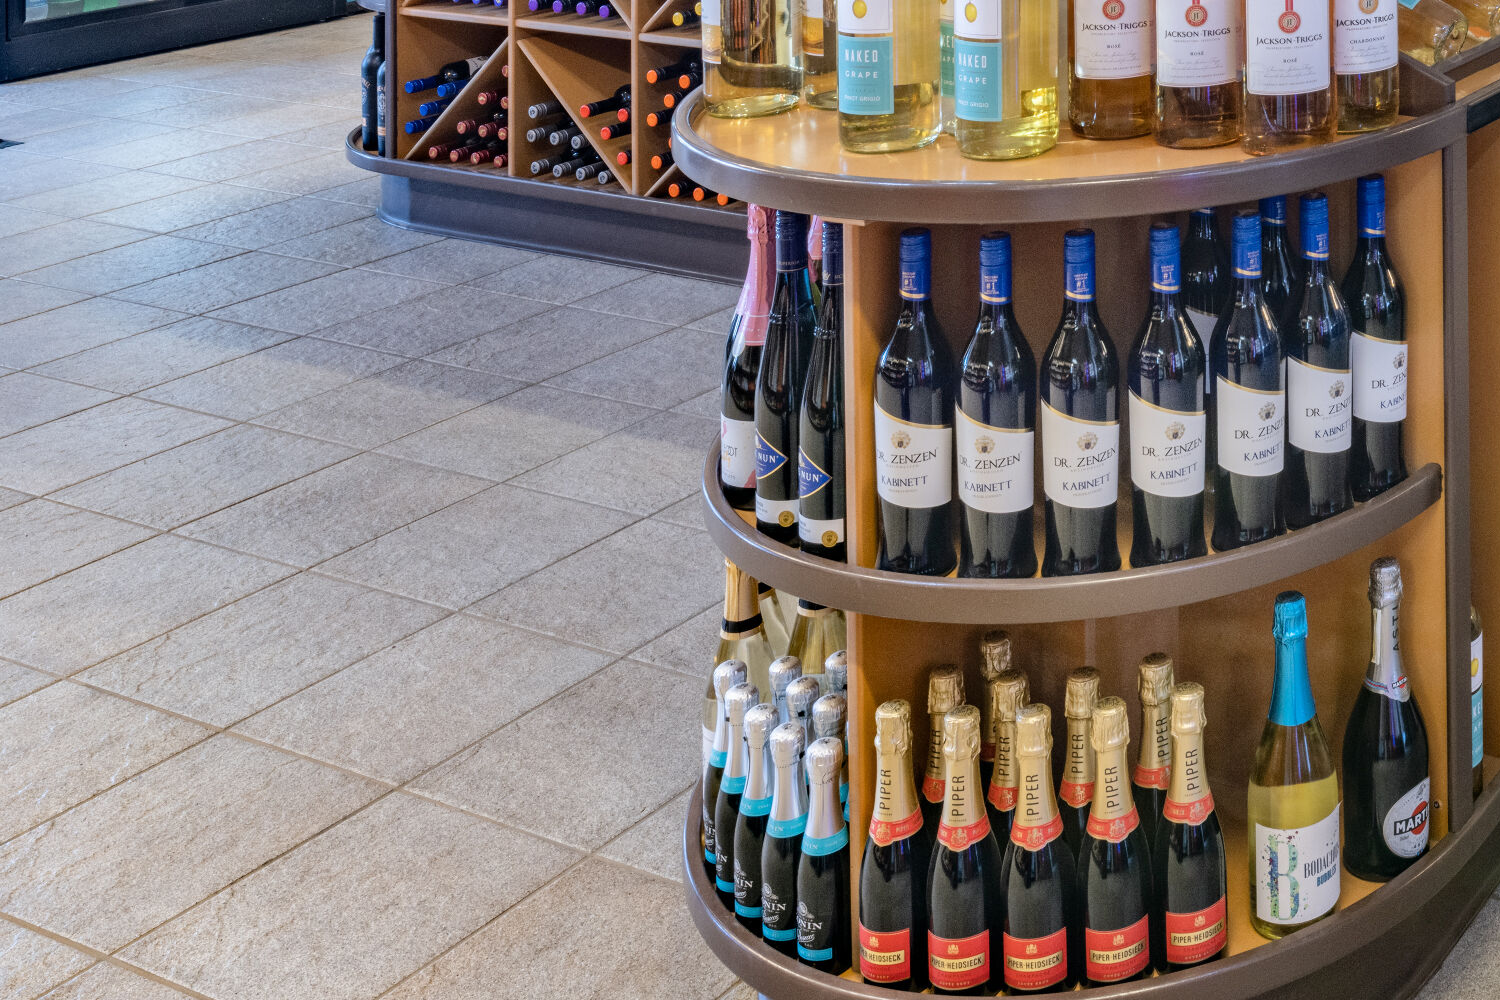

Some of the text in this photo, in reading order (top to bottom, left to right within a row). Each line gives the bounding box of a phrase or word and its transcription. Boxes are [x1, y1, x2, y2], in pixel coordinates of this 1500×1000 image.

[844, 49, 879, 63] NAKED
[958, 52, 987, 69] NAKED
[844, 70, 879, 79] GRAPE
[958, 74, 987, 85] GRAPE
[1371, 378, 1388, 390] DR.
[1305, 407, 1322, 418] DR.
[1234, 428, 1252, 440] DR.
[890, 449, 937, 464] ZENZEN
[1142, 437, 1202, 458] DR. ZENZEN
[757, 453, 778, 464] NUN
[959, 452, 1021, 470] DR. ZENZEN
[1054, 446, 1117, 468] DR. ZENZEN
[800, 472, 821, 483] NUN
[1150, 461, 1199, 480] KABINETT
[881, 475, 929, 487] KABINETT
[964, 480, 1013, 493] KABINETT
[1062, 475, 1110, 493] KABINETT
[1156, 715, 1169, 758] PIPER
[931, 728, 942, 770] PIPER
[998, 735, 1011, 777] PIPER
[1070, 733, 1084, 774] PIPER
[1185, 748, 1200, 791] PIPER
[879, 768, 891, 811] PIPER
[1026, 773, 1039, 817] PIPER
[1106, 764, 1120, 809] PIPER
[951, 774, 965, 818] PIPER
